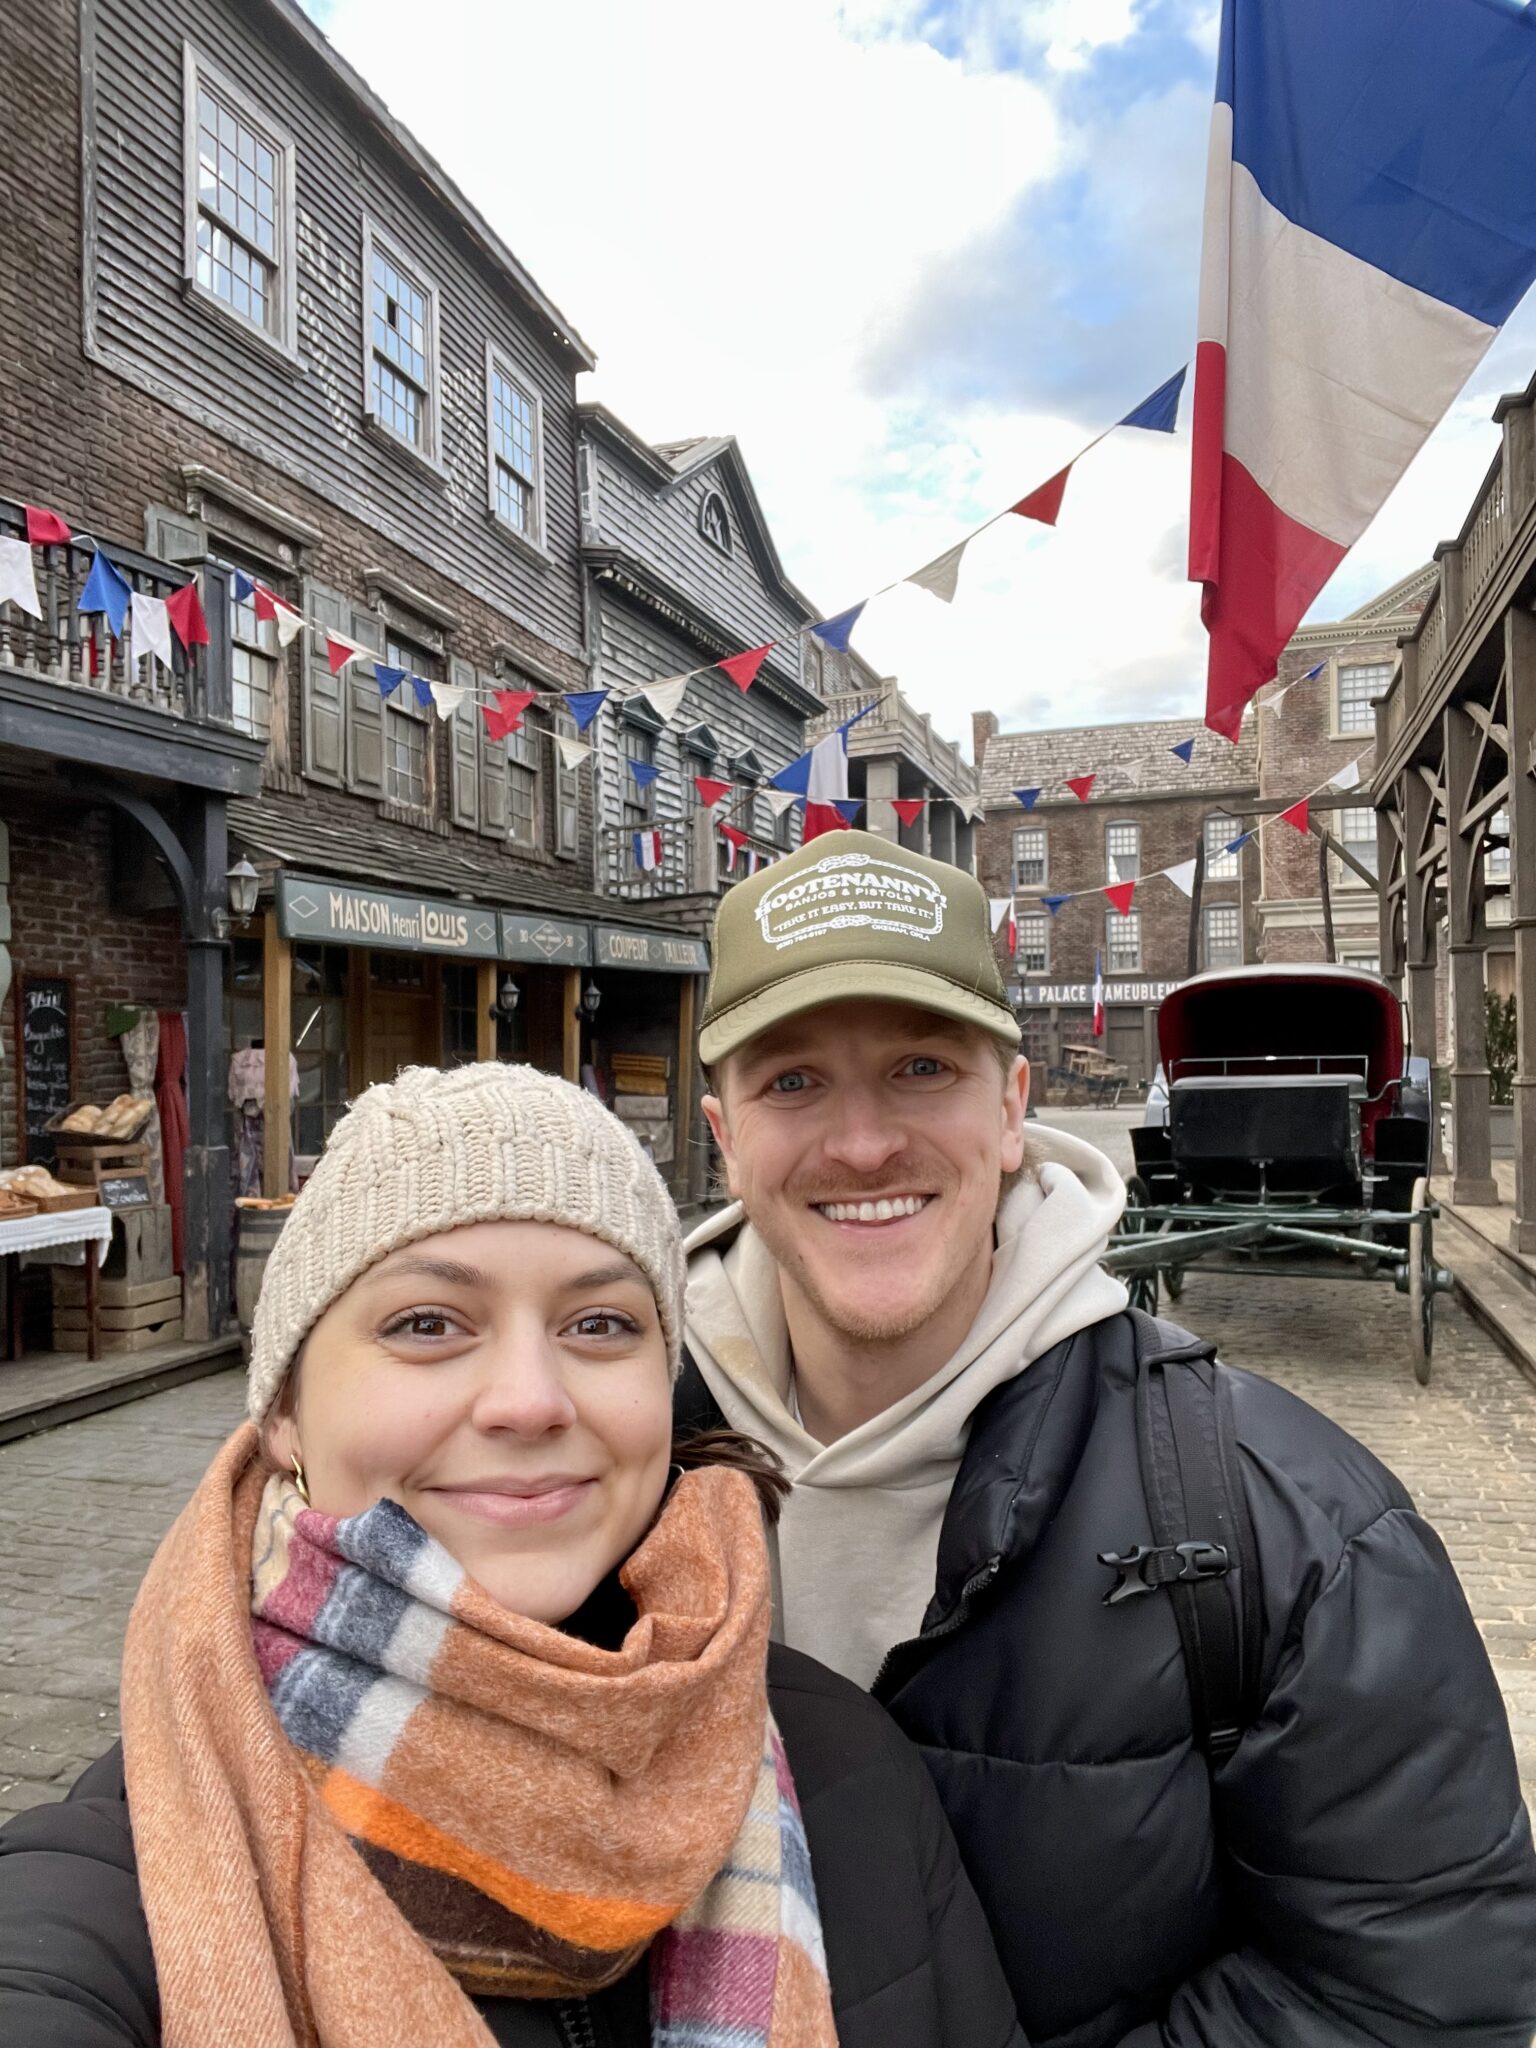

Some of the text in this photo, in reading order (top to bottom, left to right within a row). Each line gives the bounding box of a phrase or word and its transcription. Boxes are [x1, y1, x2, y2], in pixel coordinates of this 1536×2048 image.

[785, 888, 912, 911] BANJOS & PISTOLS
[809, 908, 820, 919] IT
[859, 901, 883, 910] BUT
[884, 902, 918, 915] TAKE
[329, 891, 469, 947] MAISON Henri LOUIS
[609, 935, 698, 965] COUPEUR TAILLEUR
[1039, 986, 1086, 1003] PALACE
